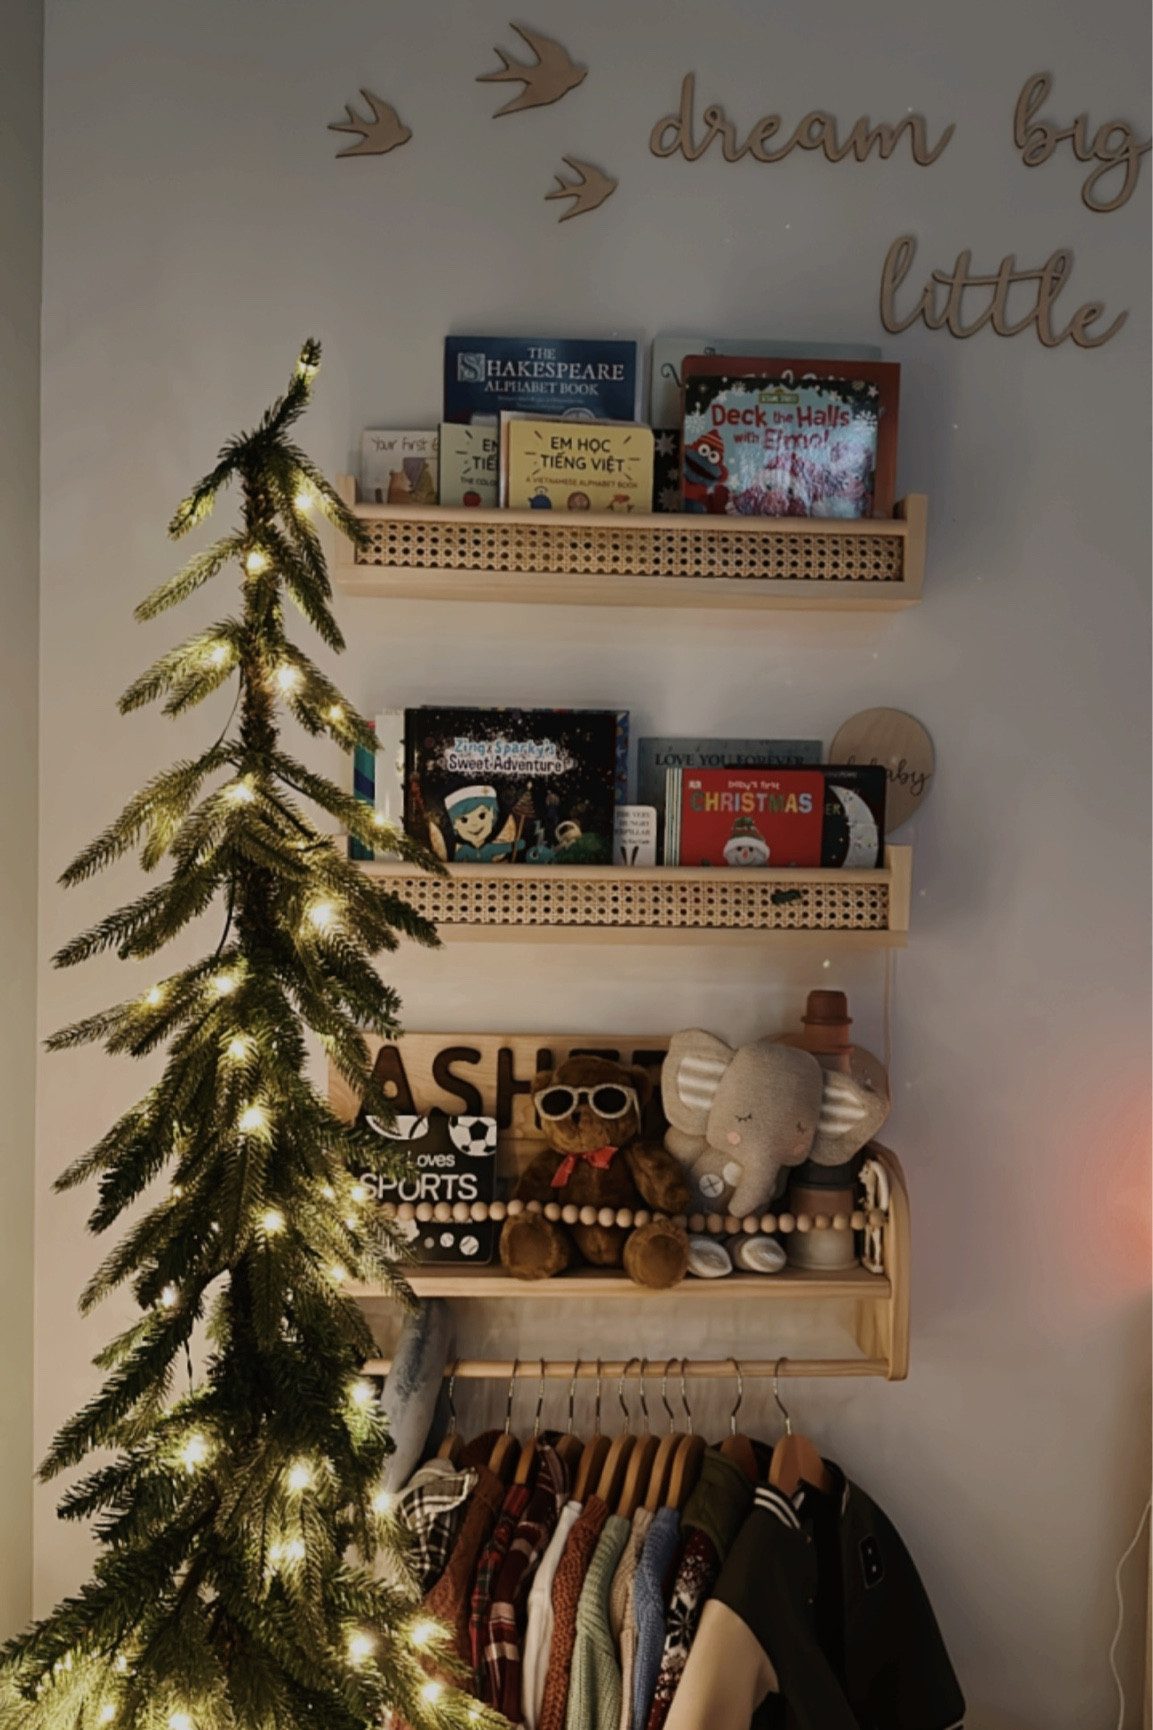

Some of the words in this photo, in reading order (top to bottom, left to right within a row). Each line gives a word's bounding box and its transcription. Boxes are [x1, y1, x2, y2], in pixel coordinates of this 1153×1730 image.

[650, 71, 955, 165] dream
[1014, 71, 1151, 212] big
[880, 235, 1128, 348] little
[527, 346, 557, 361] THE
[457, 352, 625, 383] SHAKESPEARE
[484, 381, 558, 395] ALPHABET
[559, 383, 600, 396] BOOK
[711, 403, 768, 428] Deck
[773, 411, 794, 424] the
[796, 403, 850, 428] Halls
[550, 436, 573, 450] EM
[578, 438, 611, 453] HỌC
[734, 431, 760, 444] with
[449, 754, 491, 770] Sweet
[493, 755, 562, 773] Adventure
[655, 753, 695, 766] LOVE
[699, 753, 731, 766] YOU
[691, 790, 813, 814] CHRISTMAS
[355, 1044, 668, 1131] ASH
[359, 1172, 478, 1201] SPORTS
